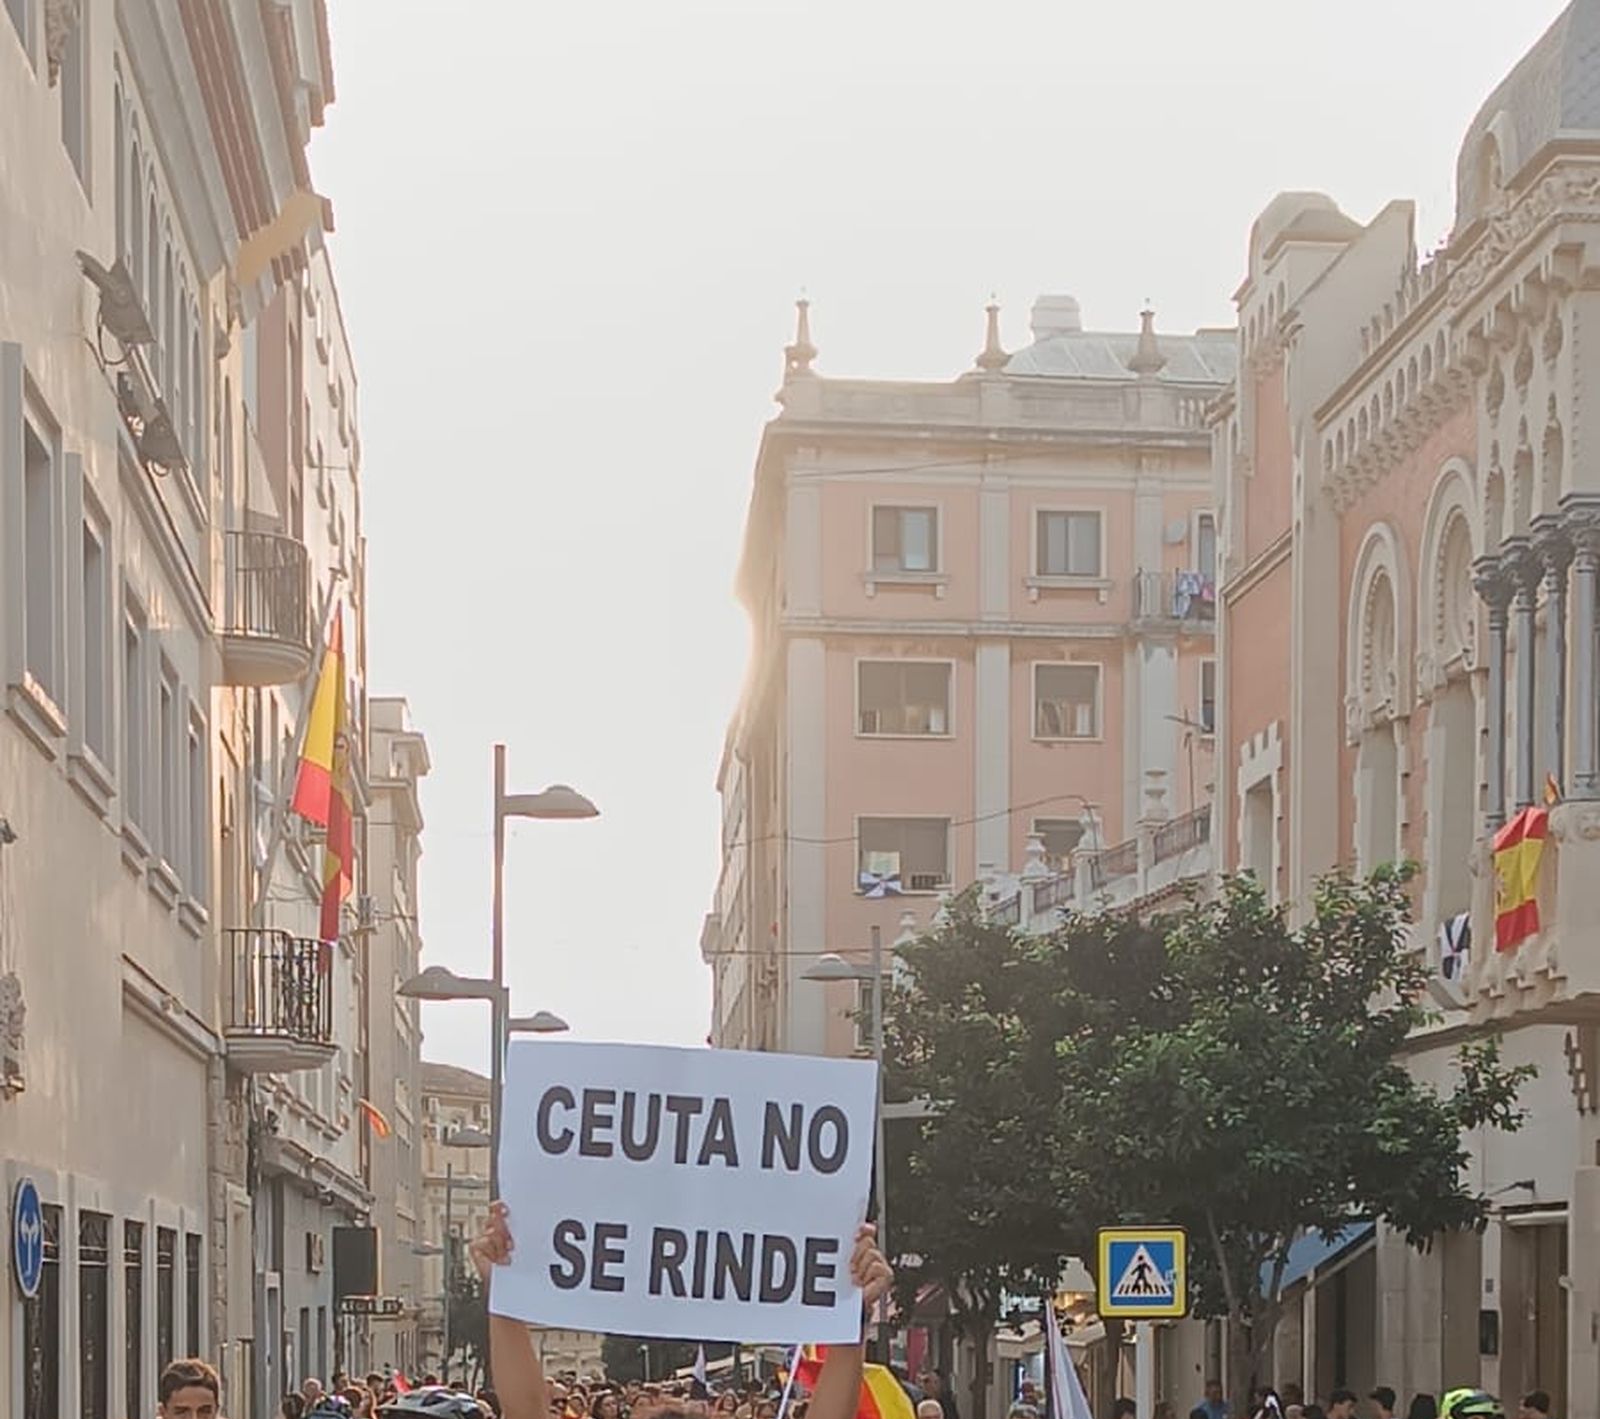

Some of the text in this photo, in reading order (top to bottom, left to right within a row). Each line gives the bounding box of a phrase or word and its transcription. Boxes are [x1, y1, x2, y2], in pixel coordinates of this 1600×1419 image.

[537, 1085, 849, 1174] CEUTA NO
[550, 1218, 839, 1307] SE RINDE
